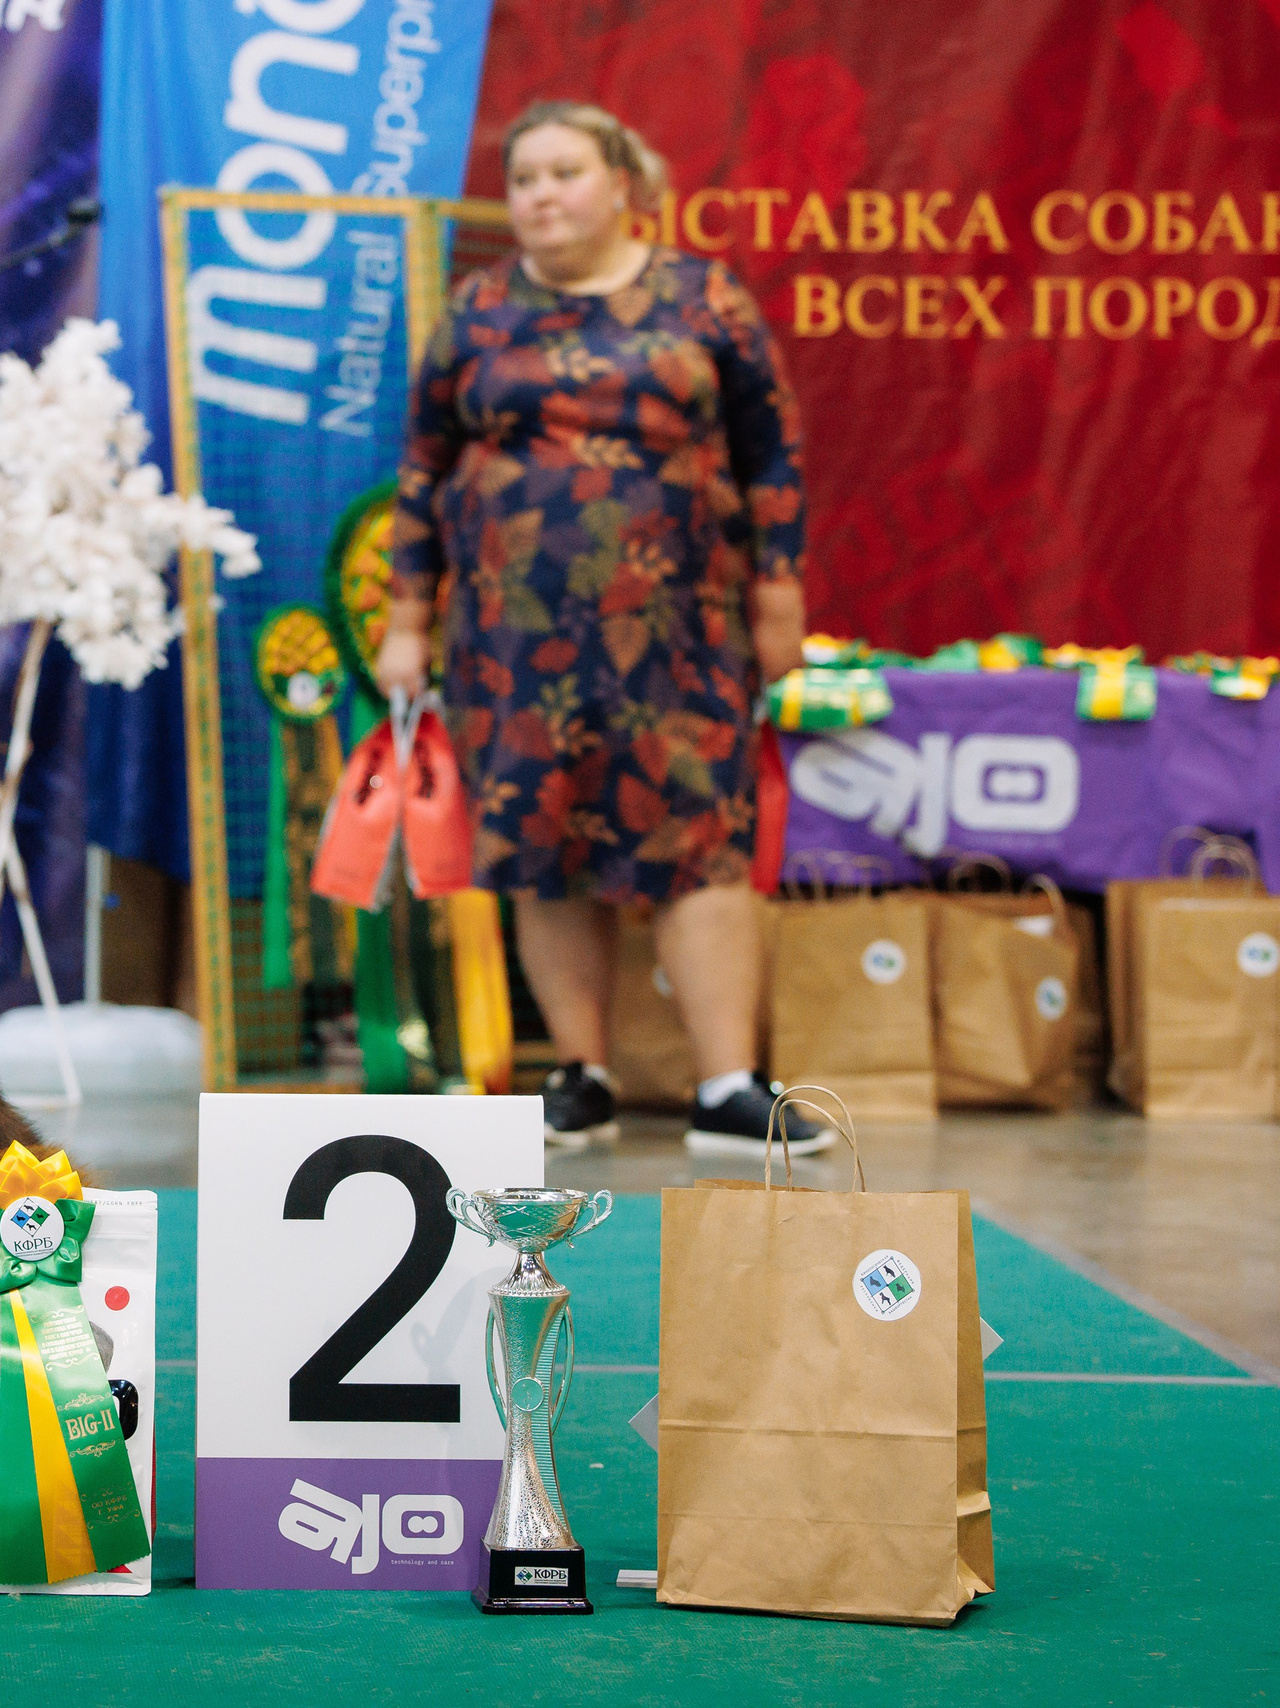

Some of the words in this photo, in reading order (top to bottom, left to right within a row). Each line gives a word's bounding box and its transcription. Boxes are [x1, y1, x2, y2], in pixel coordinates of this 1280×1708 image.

[349, 0, 443, 198] Superp
[619, 187, 1010, 254] ЫСТАВКА
[320, 229, 401, 438] Natural
[793, 276, 1006, 338] ВСЕХ
[14, 1237, 53, 1252] КФРБ
[282, 1134, 460, 1423] 2
[65, 1409, 115, 1440] BIG-II
[534, 1569, 567, 1579] КФРБ
